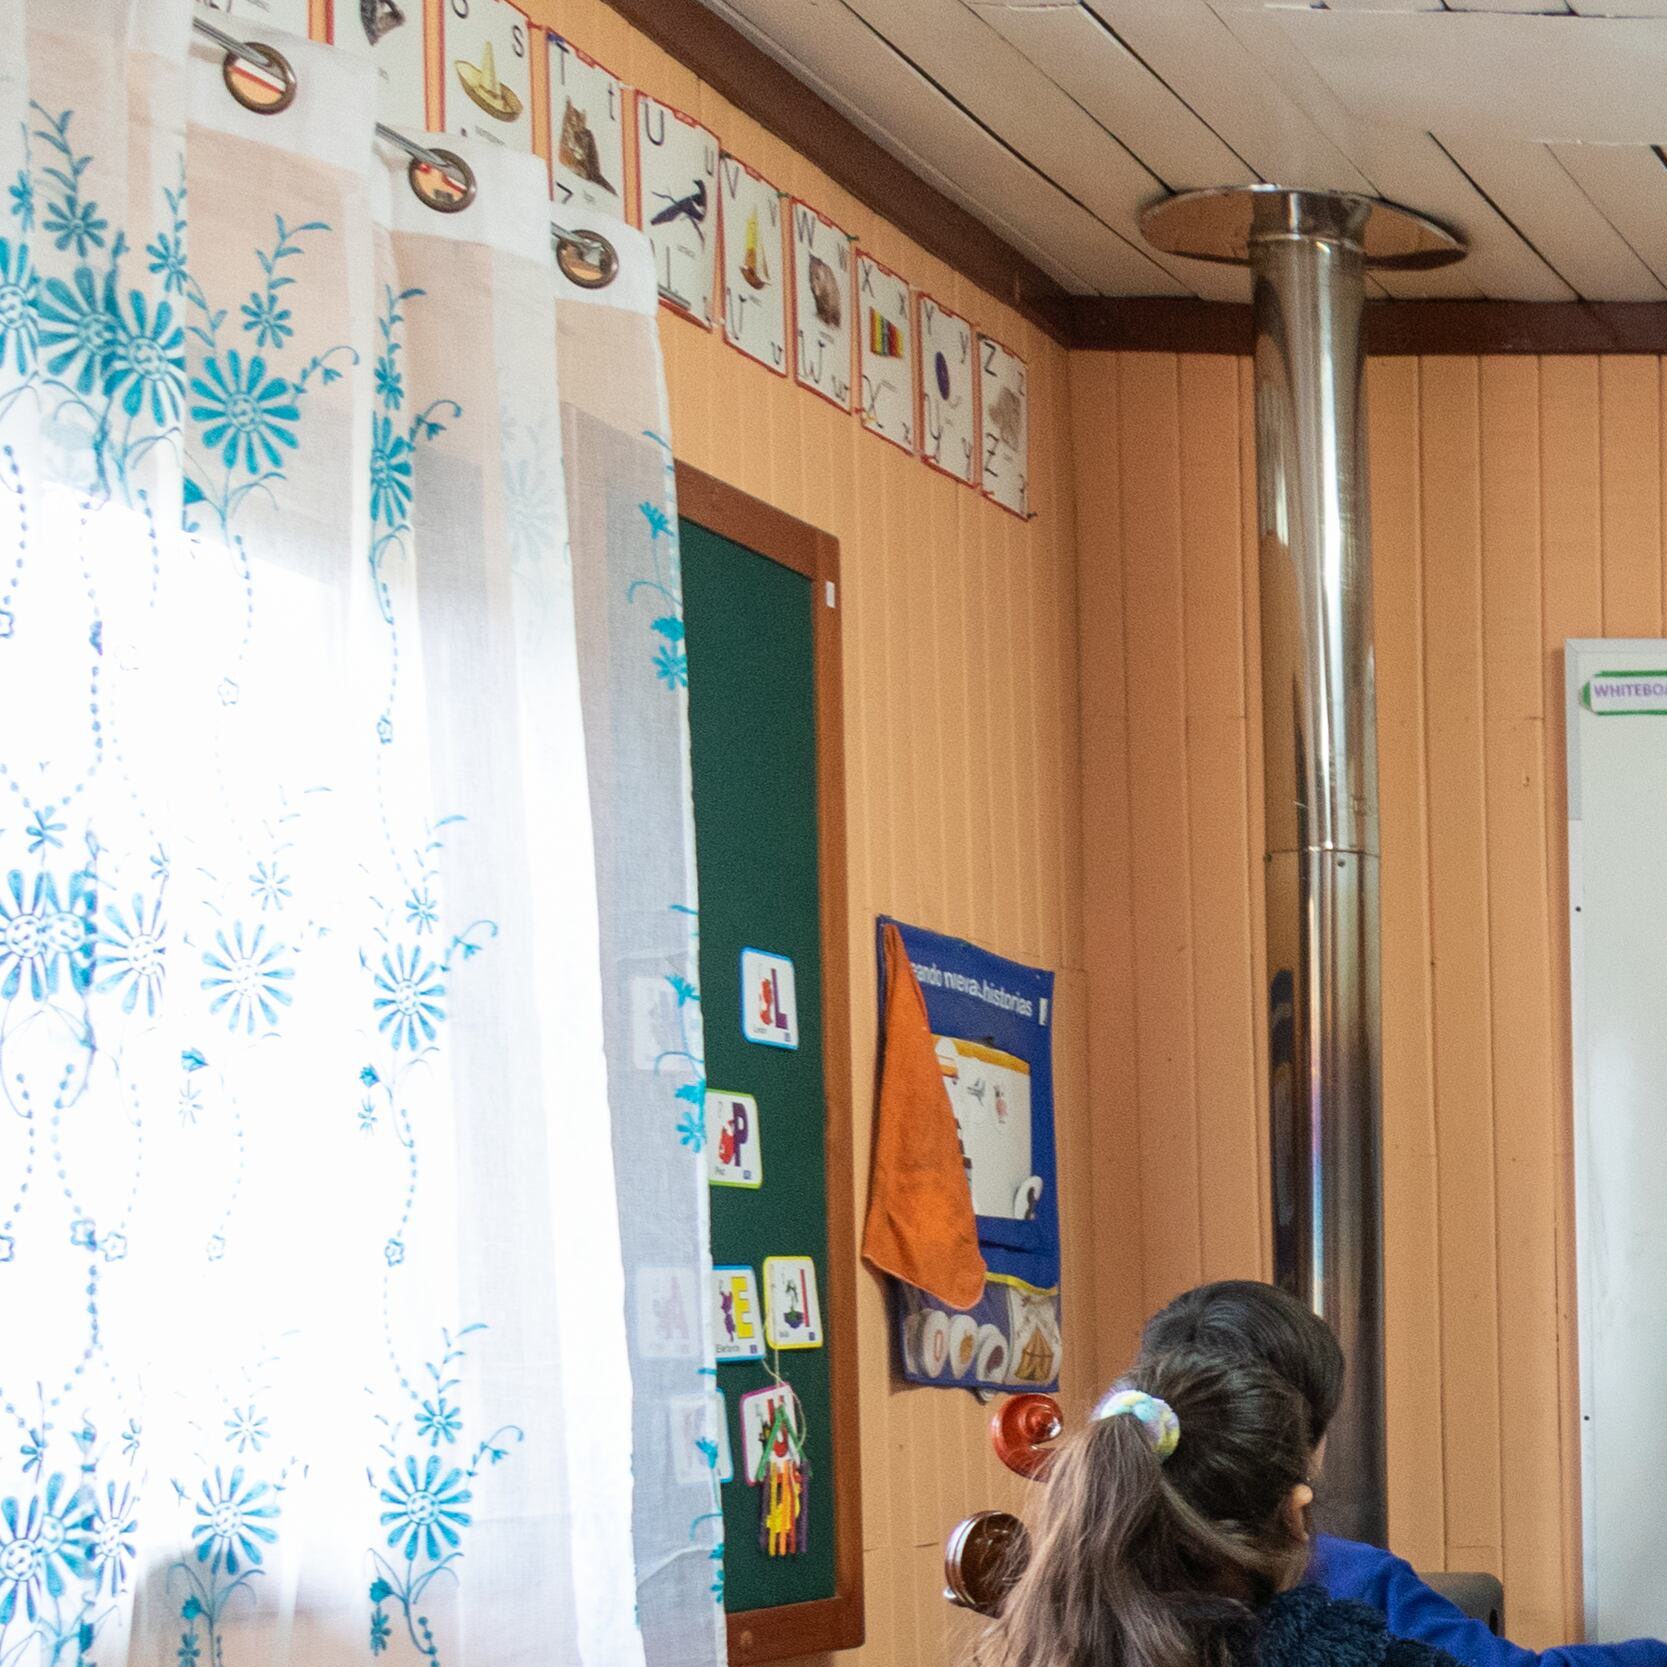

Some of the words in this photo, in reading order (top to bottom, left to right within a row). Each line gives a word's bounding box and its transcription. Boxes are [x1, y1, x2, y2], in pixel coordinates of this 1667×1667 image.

[556, 40, 570, 86] T
[608, 84, 617, 121] t
[644, 103, 665, 146] U
[704, 147, 715, 177] u
[725, 157, 740, 200] V
[796, 211, 817, 247] W
[861, 260, 874, 298] X
[924, 301, 935, 335] Y
[984, 341, 998, 377] Z
[771, 968, 788, 1029] L
[732, 1102, 748, 1167] P
[730, 1276, 755, 1339] E
